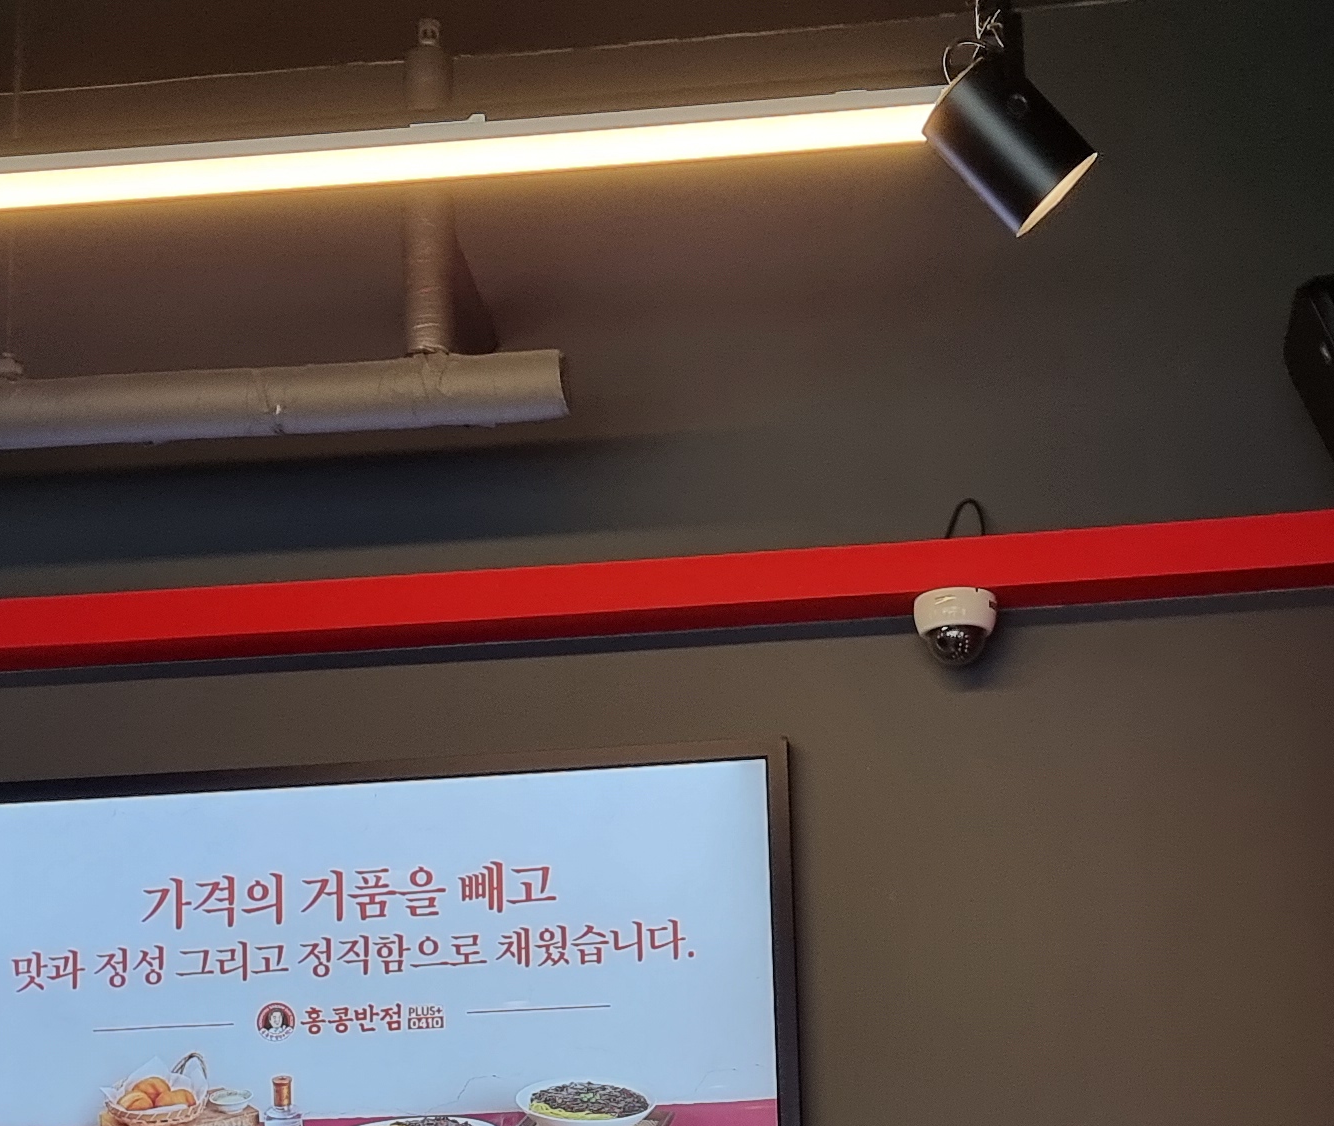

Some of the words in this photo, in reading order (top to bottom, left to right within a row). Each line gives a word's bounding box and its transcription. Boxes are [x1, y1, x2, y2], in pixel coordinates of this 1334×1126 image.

[141, 872, 284, 930] 가격의
[300, 865, 446, 922] 거품을
[457, 861, 557, 913] 빼고
[11, 949, 86, 993] 맛과
[94, 944, 166, 988] 정성
[175, 941, 289, 982] 그리고
[298, 933, 488, 978] 정직함으로
[495, 919, 695, 967] 채웠습니다.
[300, 1003, 402, 1035] 홍콩반점
[408, 1006, 443, 1017] PLUS+
[410, 1017, 442, 1029] 0410
